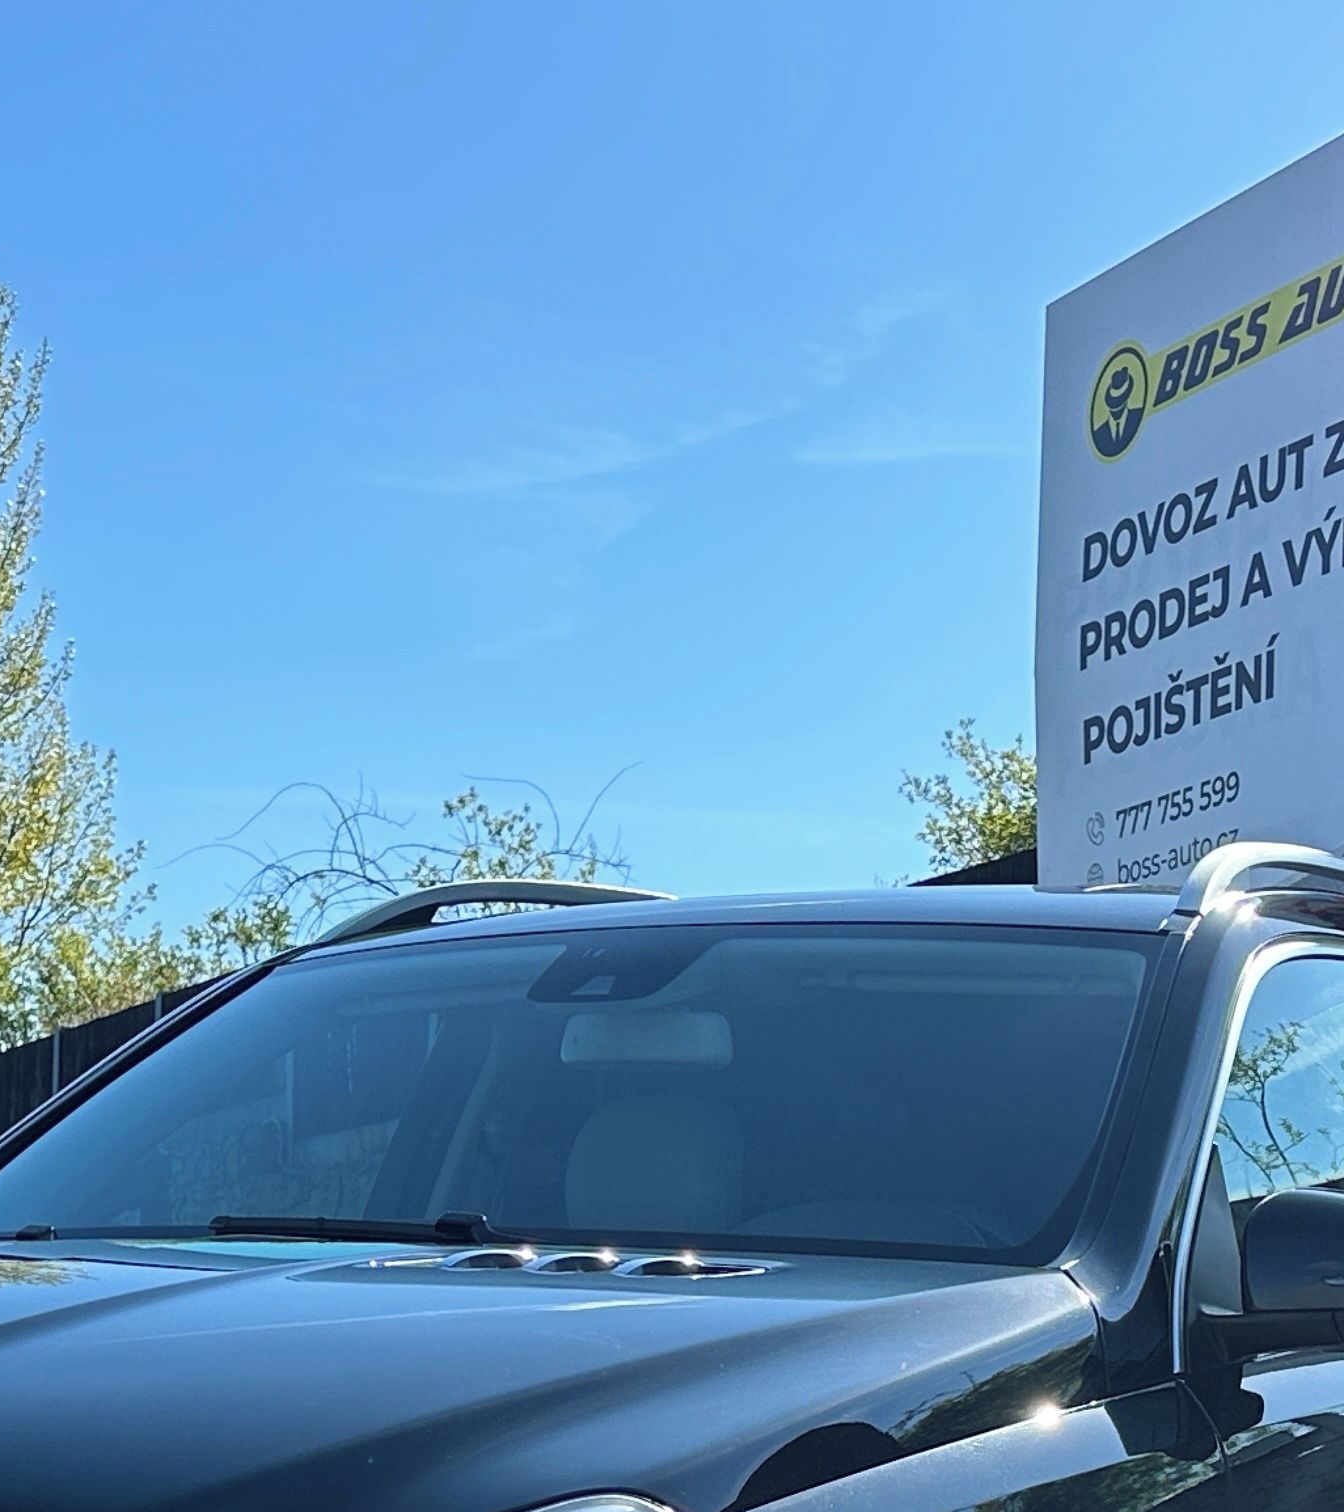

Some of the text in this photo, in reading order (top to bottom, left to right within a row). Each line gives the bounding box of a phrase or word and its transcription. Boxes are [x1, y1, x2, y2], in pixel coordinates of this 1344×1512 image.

[1153, 301, 1271, 407] BOSS
[1082, 477, 1218, 582] DOVOZ
[1226, 434, 1313, 520] AUT
[1080, 564, 1230, 671] PRODEJ
[1240, 551, 1272, 608] A
[1083, 632, 1280, 765] POJIŠTĚNÍ
[1115, 771, 1241, 839] 777 755 599
